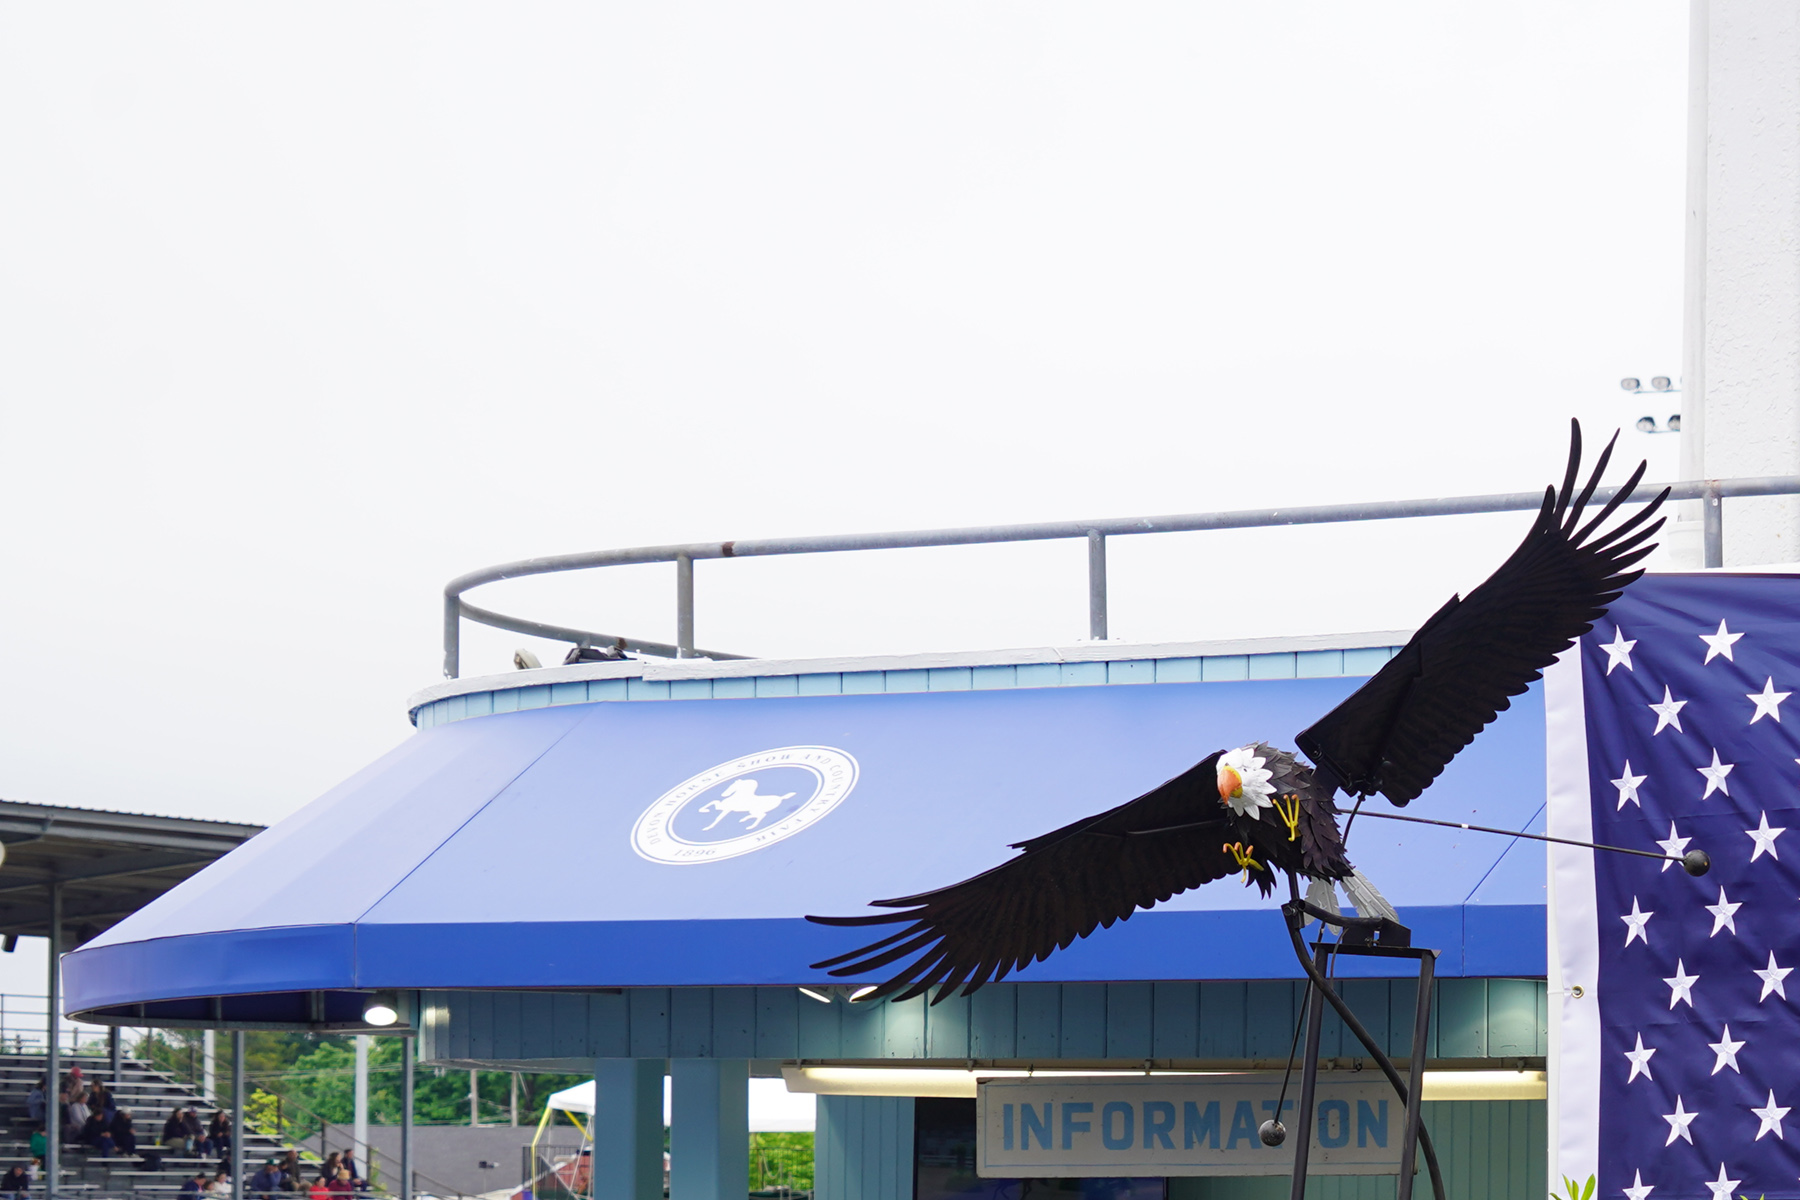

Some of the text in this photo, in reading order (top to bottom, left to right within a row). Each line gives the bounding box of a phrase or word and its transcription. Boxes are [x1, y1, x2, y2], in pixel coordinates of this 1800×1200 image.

[646, 753, 844, 845] DEVON HORSE SHOW AND COUNTRY FAIR
[673, 847, 718, 857] 1896
[1002, 1099, 1389, 1151] INFORMATON
